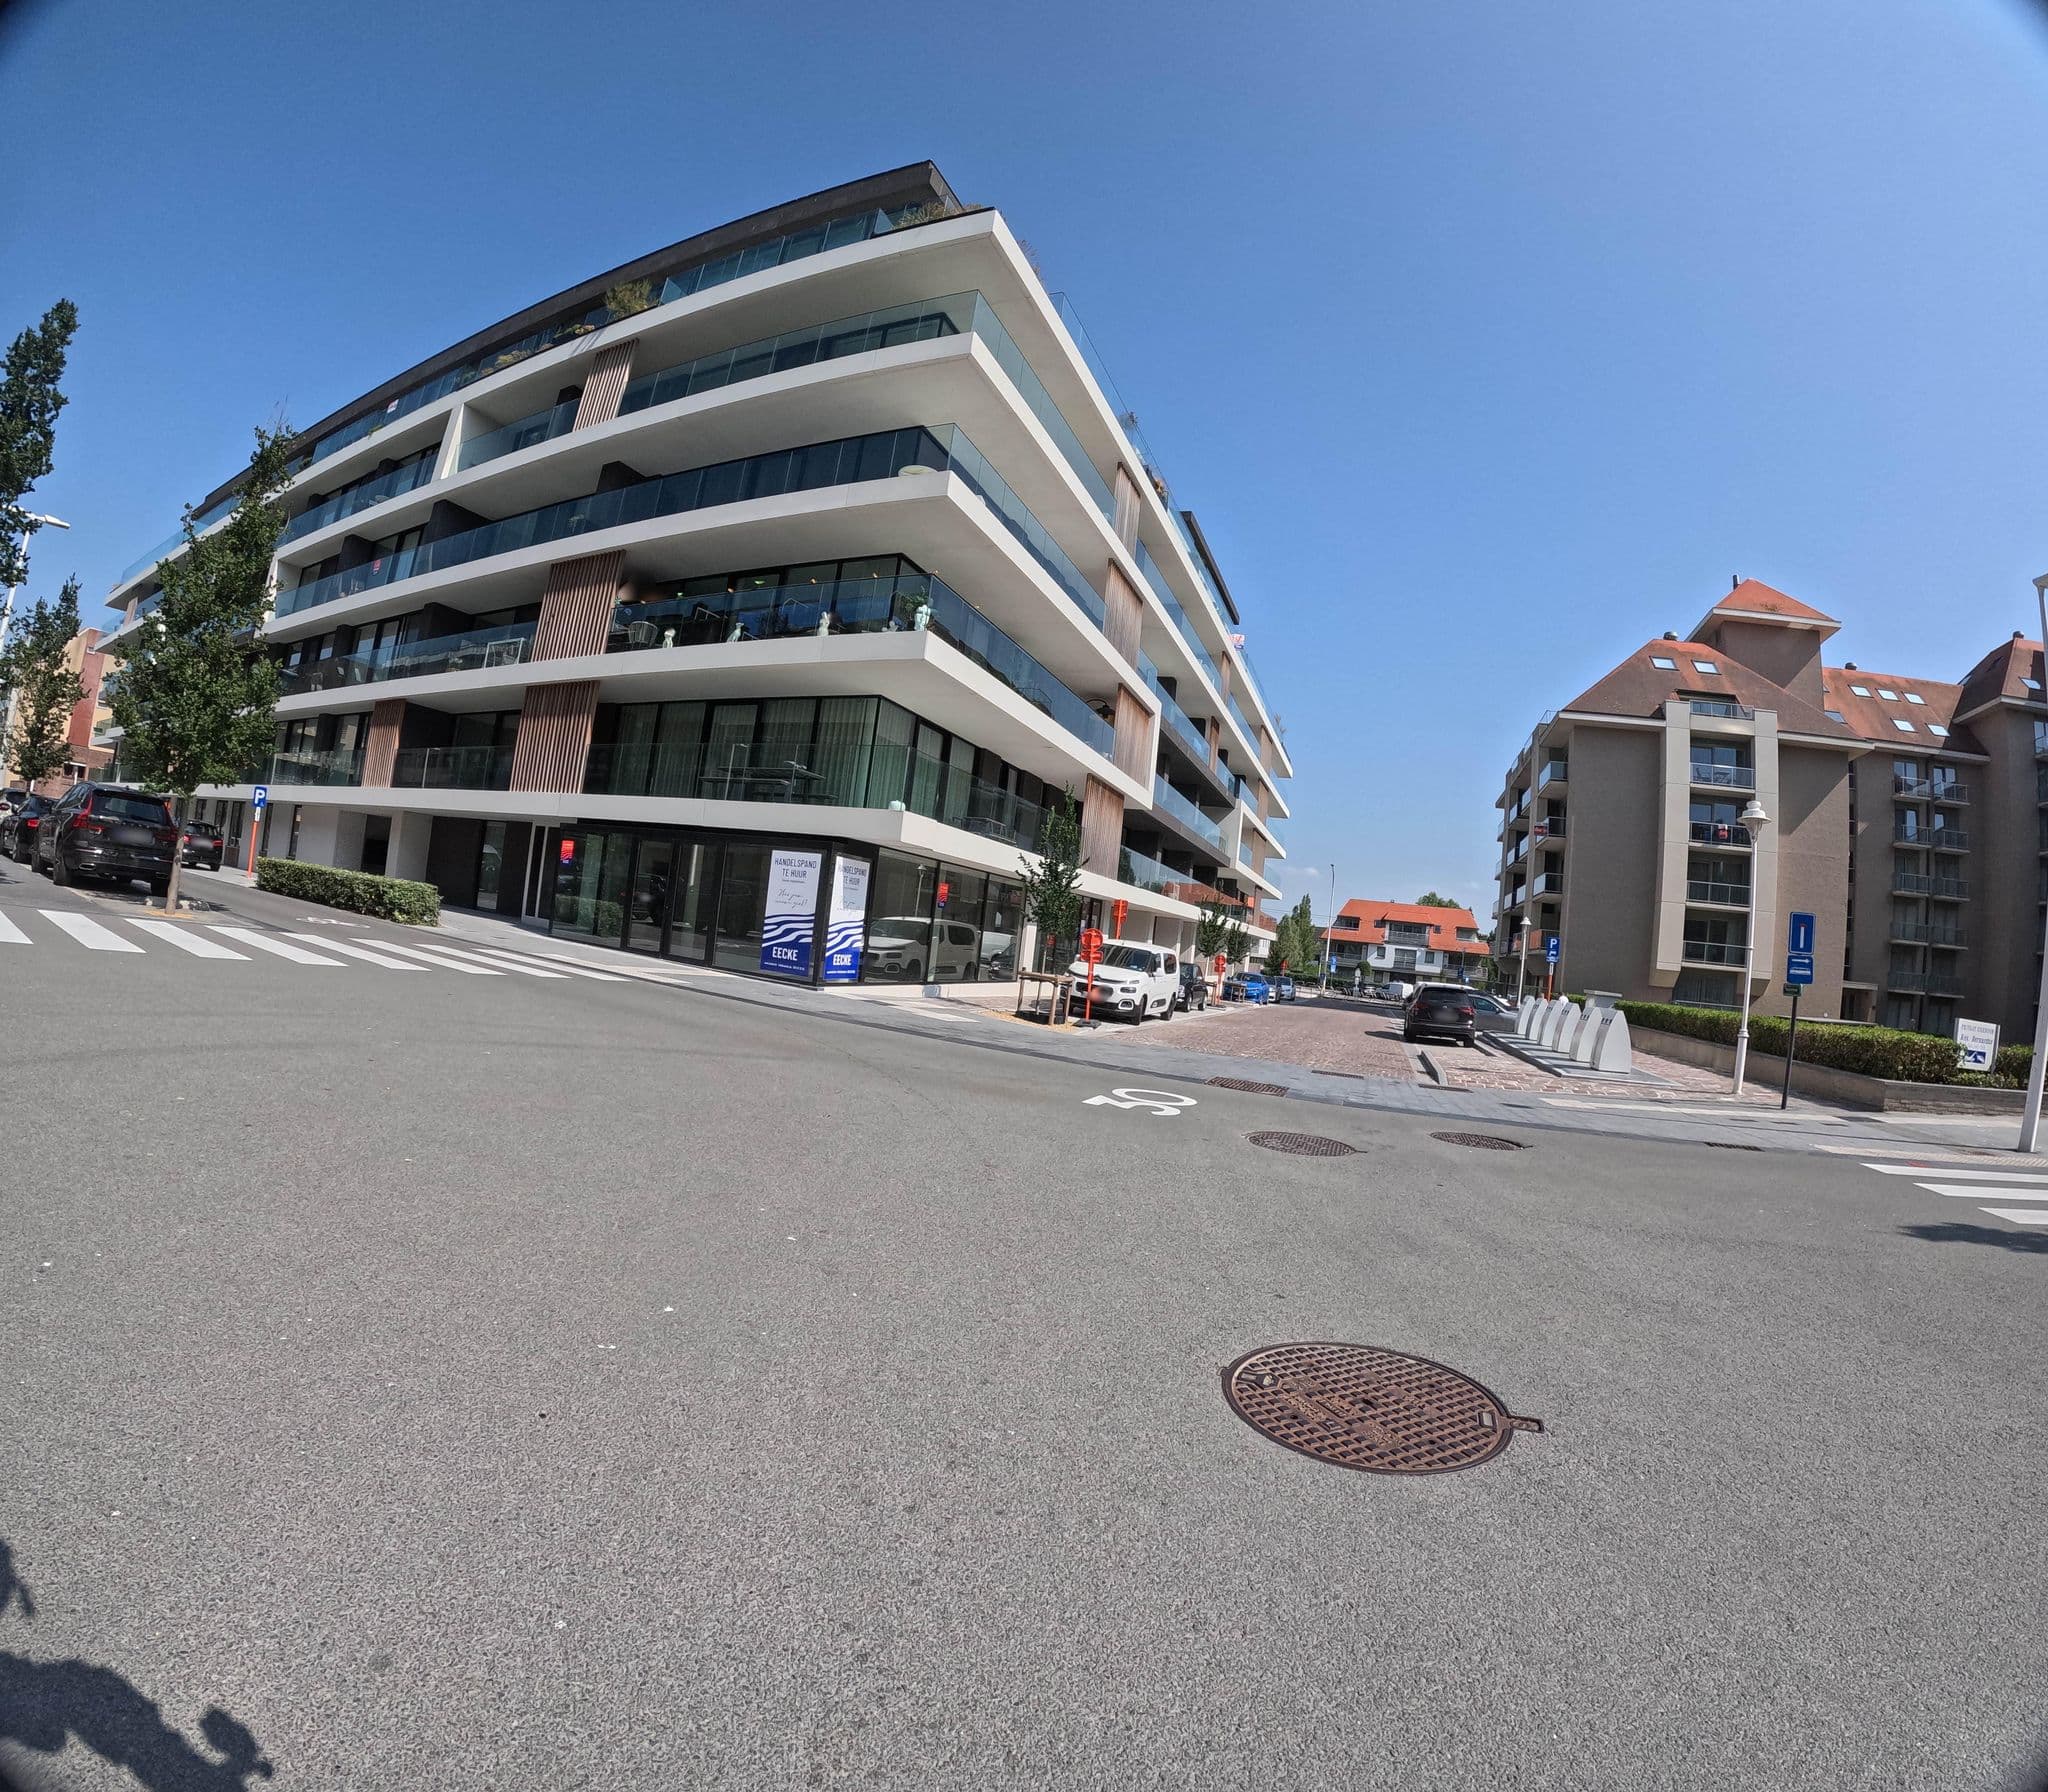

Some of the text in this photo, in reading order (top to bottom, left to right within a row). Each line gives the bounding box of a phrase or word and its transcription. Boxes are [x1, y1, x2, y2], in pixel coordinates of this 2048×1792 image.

[254, 789, 265, 804] P
[774, 857, 817, 869] HANDELSPAND
[782, 868, 807, 878] TE HUUR
[1550, 938, 1558, 949] P
[772, 946, 799, 961] EECKE
[832, 954, 852, 966] EECKE
[1081, 1088, 1198, 1115] 30
